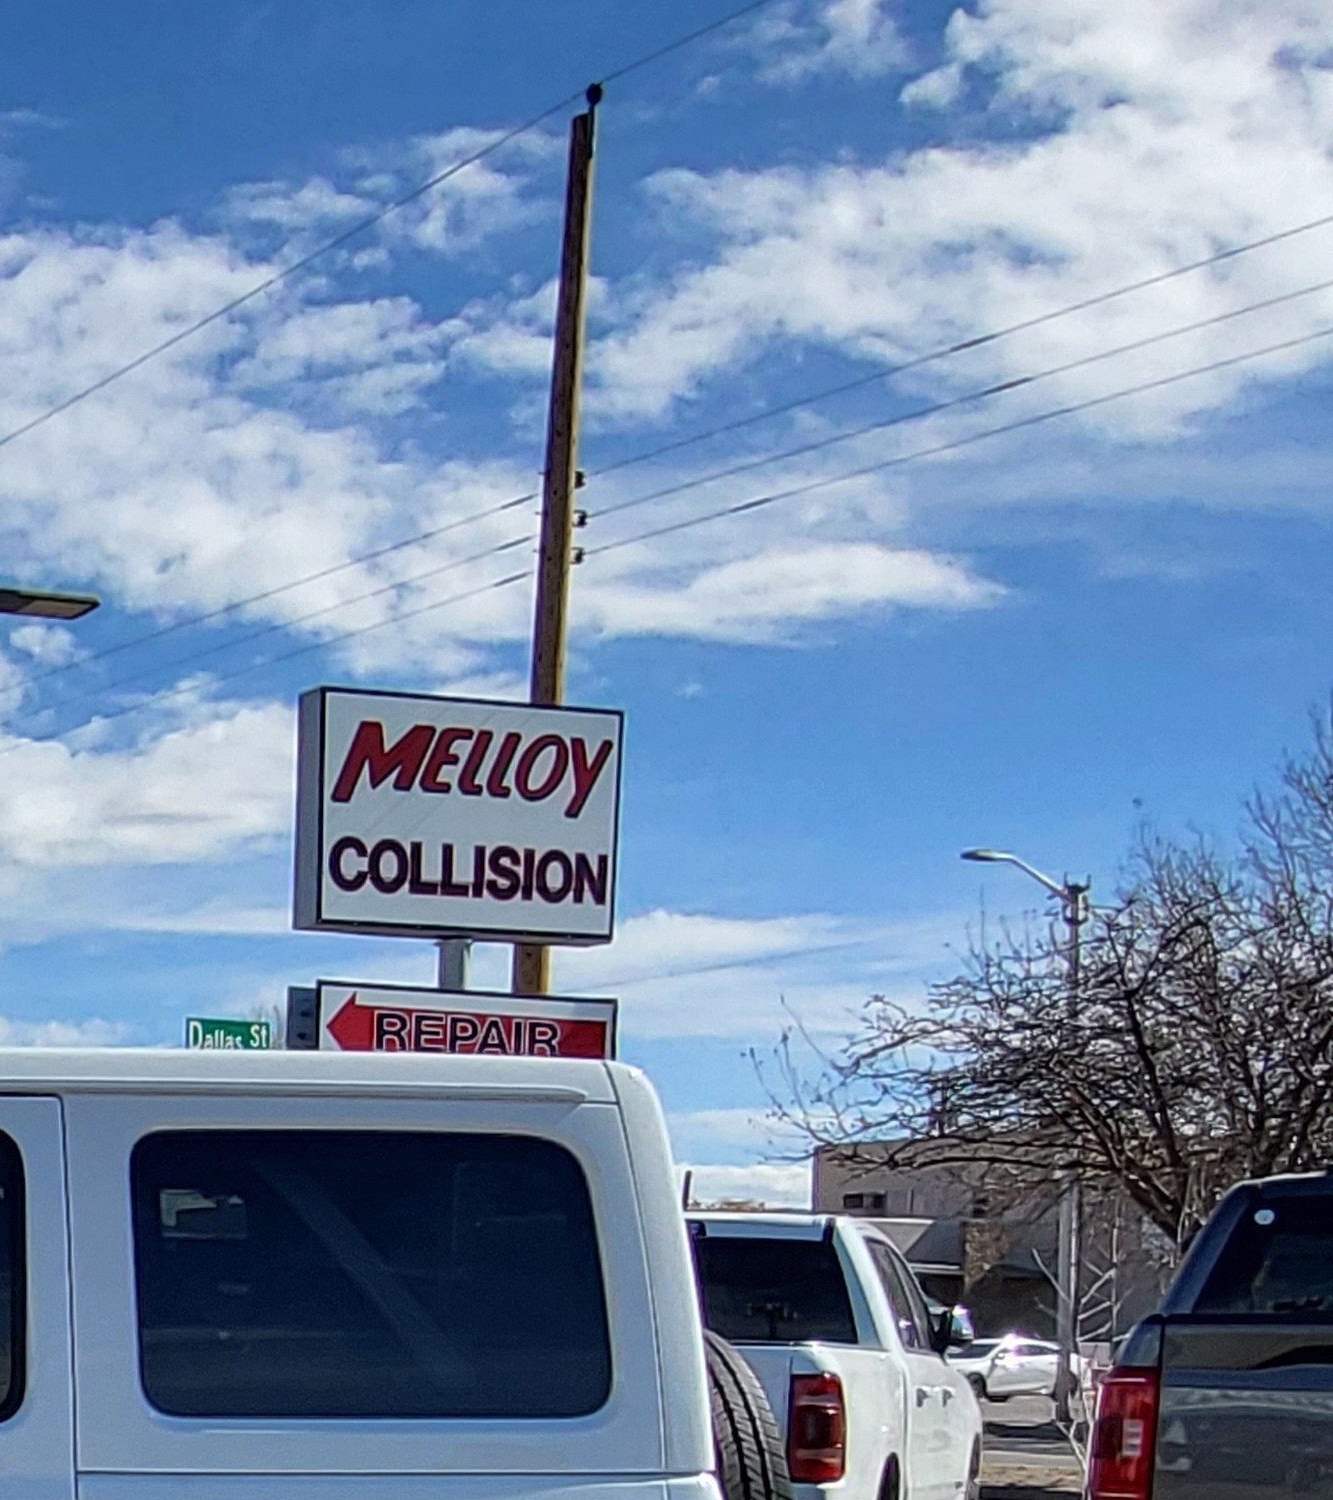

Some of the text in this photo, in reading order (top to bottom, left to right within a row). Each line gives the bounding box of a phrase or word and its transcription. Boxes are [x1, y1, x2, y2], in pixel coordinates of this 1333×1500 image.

[331, 721, 613, 818] MELLOY
[328, 836, 608, 905] COLLISION
[189, 1020, 269, 1049] Dallas St
[375, 1011, 562, 1057] REPAIR
